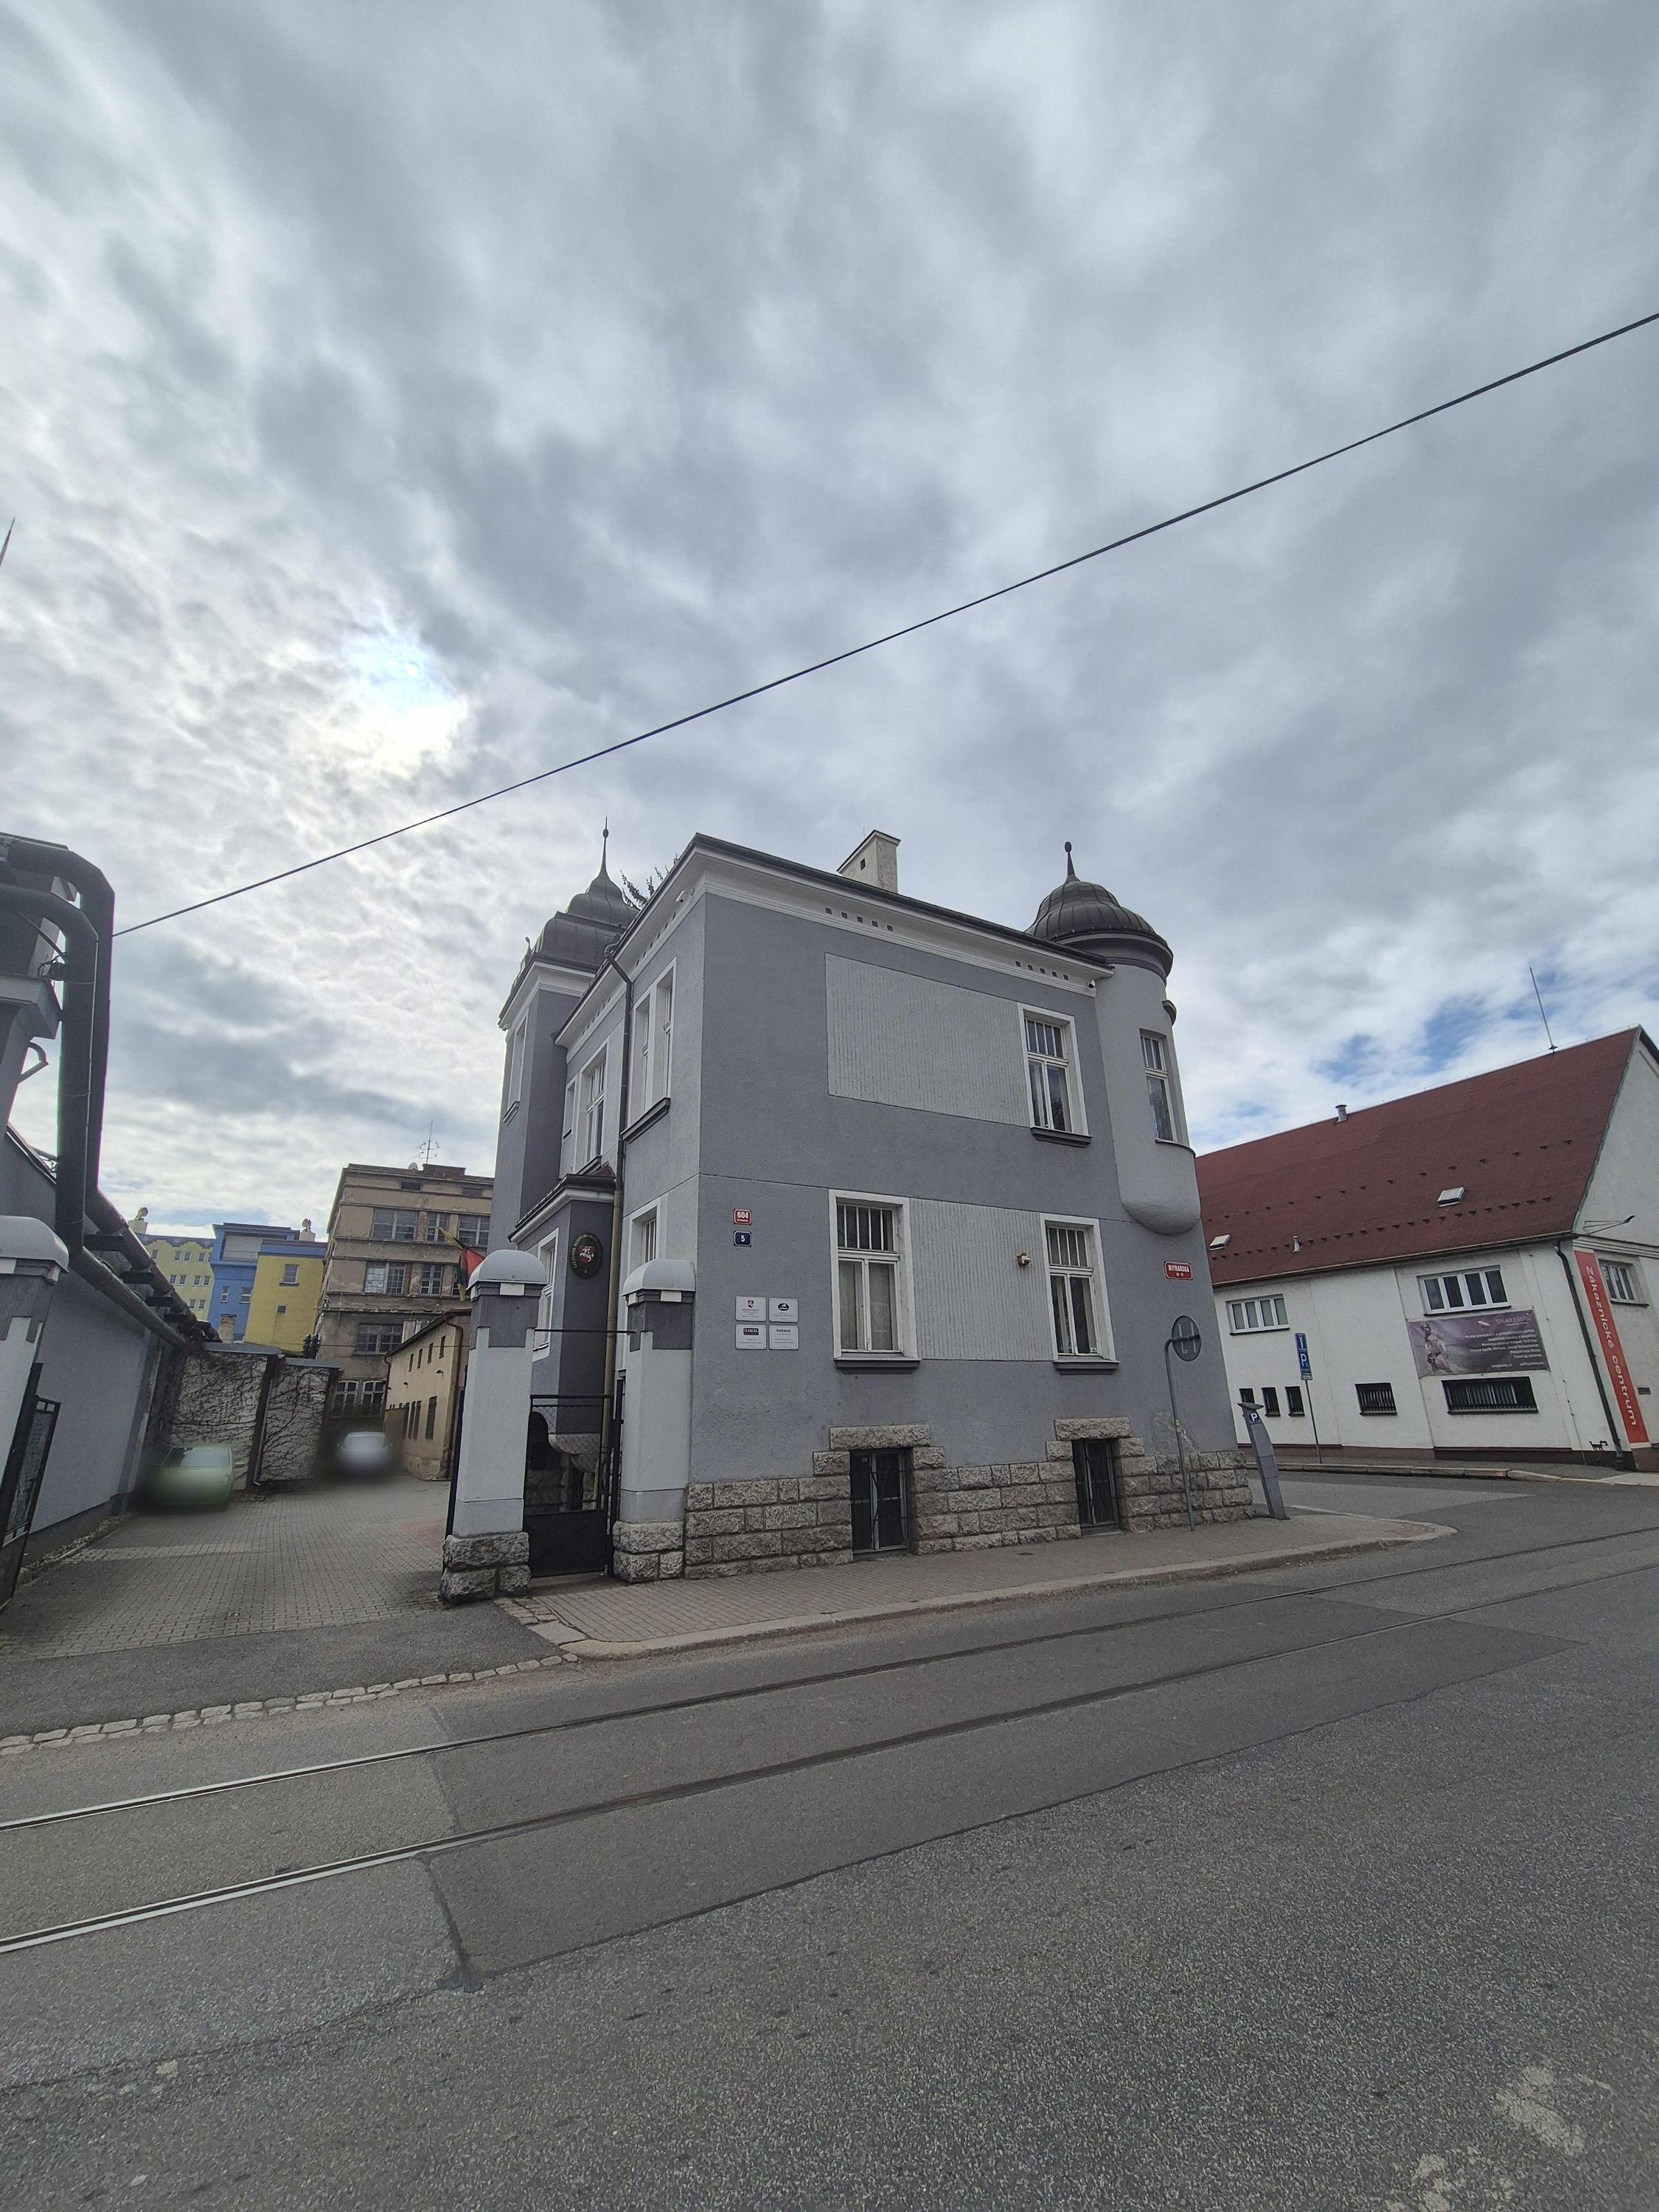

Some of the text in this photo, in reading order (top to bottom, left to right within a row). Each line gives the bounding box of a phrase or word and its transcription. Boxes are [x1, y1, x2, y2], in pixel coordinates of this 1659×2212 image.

[1585, 1265, 1637, 1426] Zákaznické centrum
[1251, 1413, 1259, 1422] P
